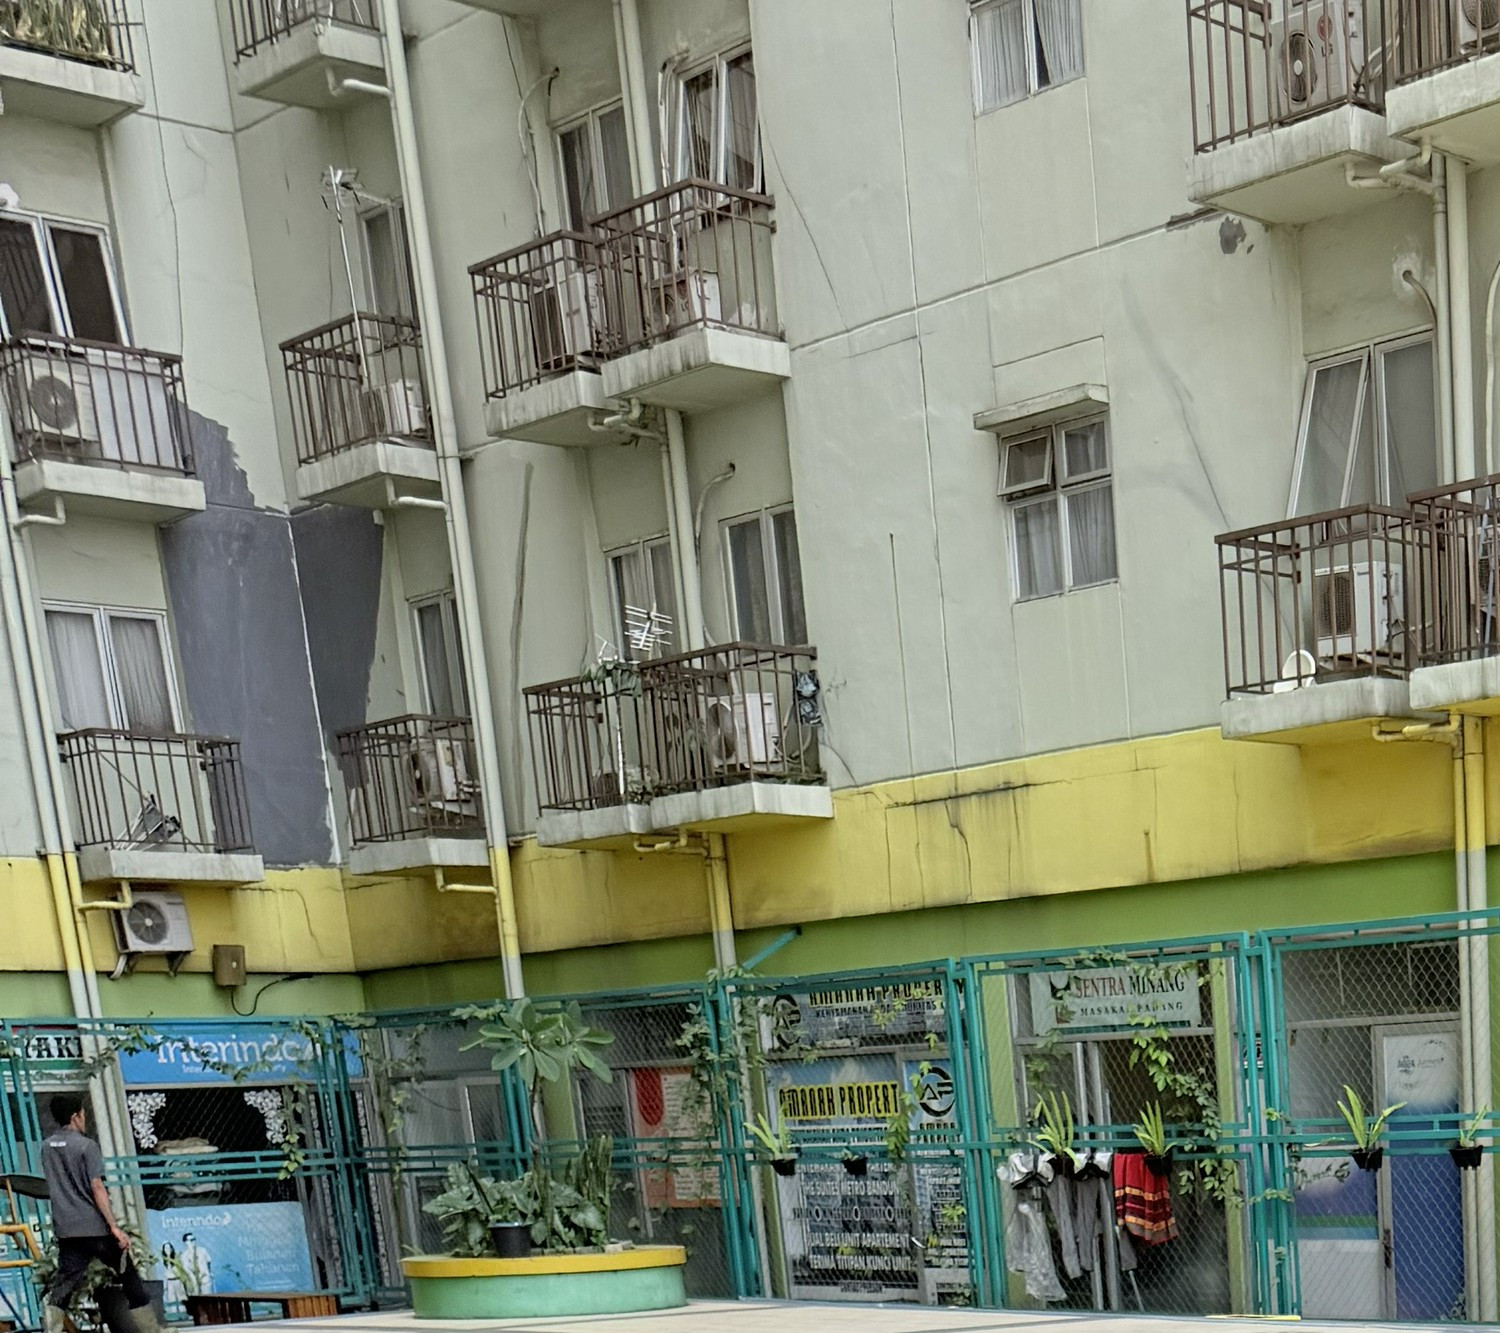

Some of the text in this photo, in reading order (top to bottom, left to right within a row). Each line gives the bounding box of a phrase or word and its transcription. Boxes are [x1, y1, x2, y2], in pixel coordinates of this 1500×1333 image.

[881, 977, 966, 1000] PROPERY
[1080, 1005, 1131, 1017] MASAKA
[155, 1034, 302, 1064] Interindo
[867, 1179, 899, 1196] BANDUN
